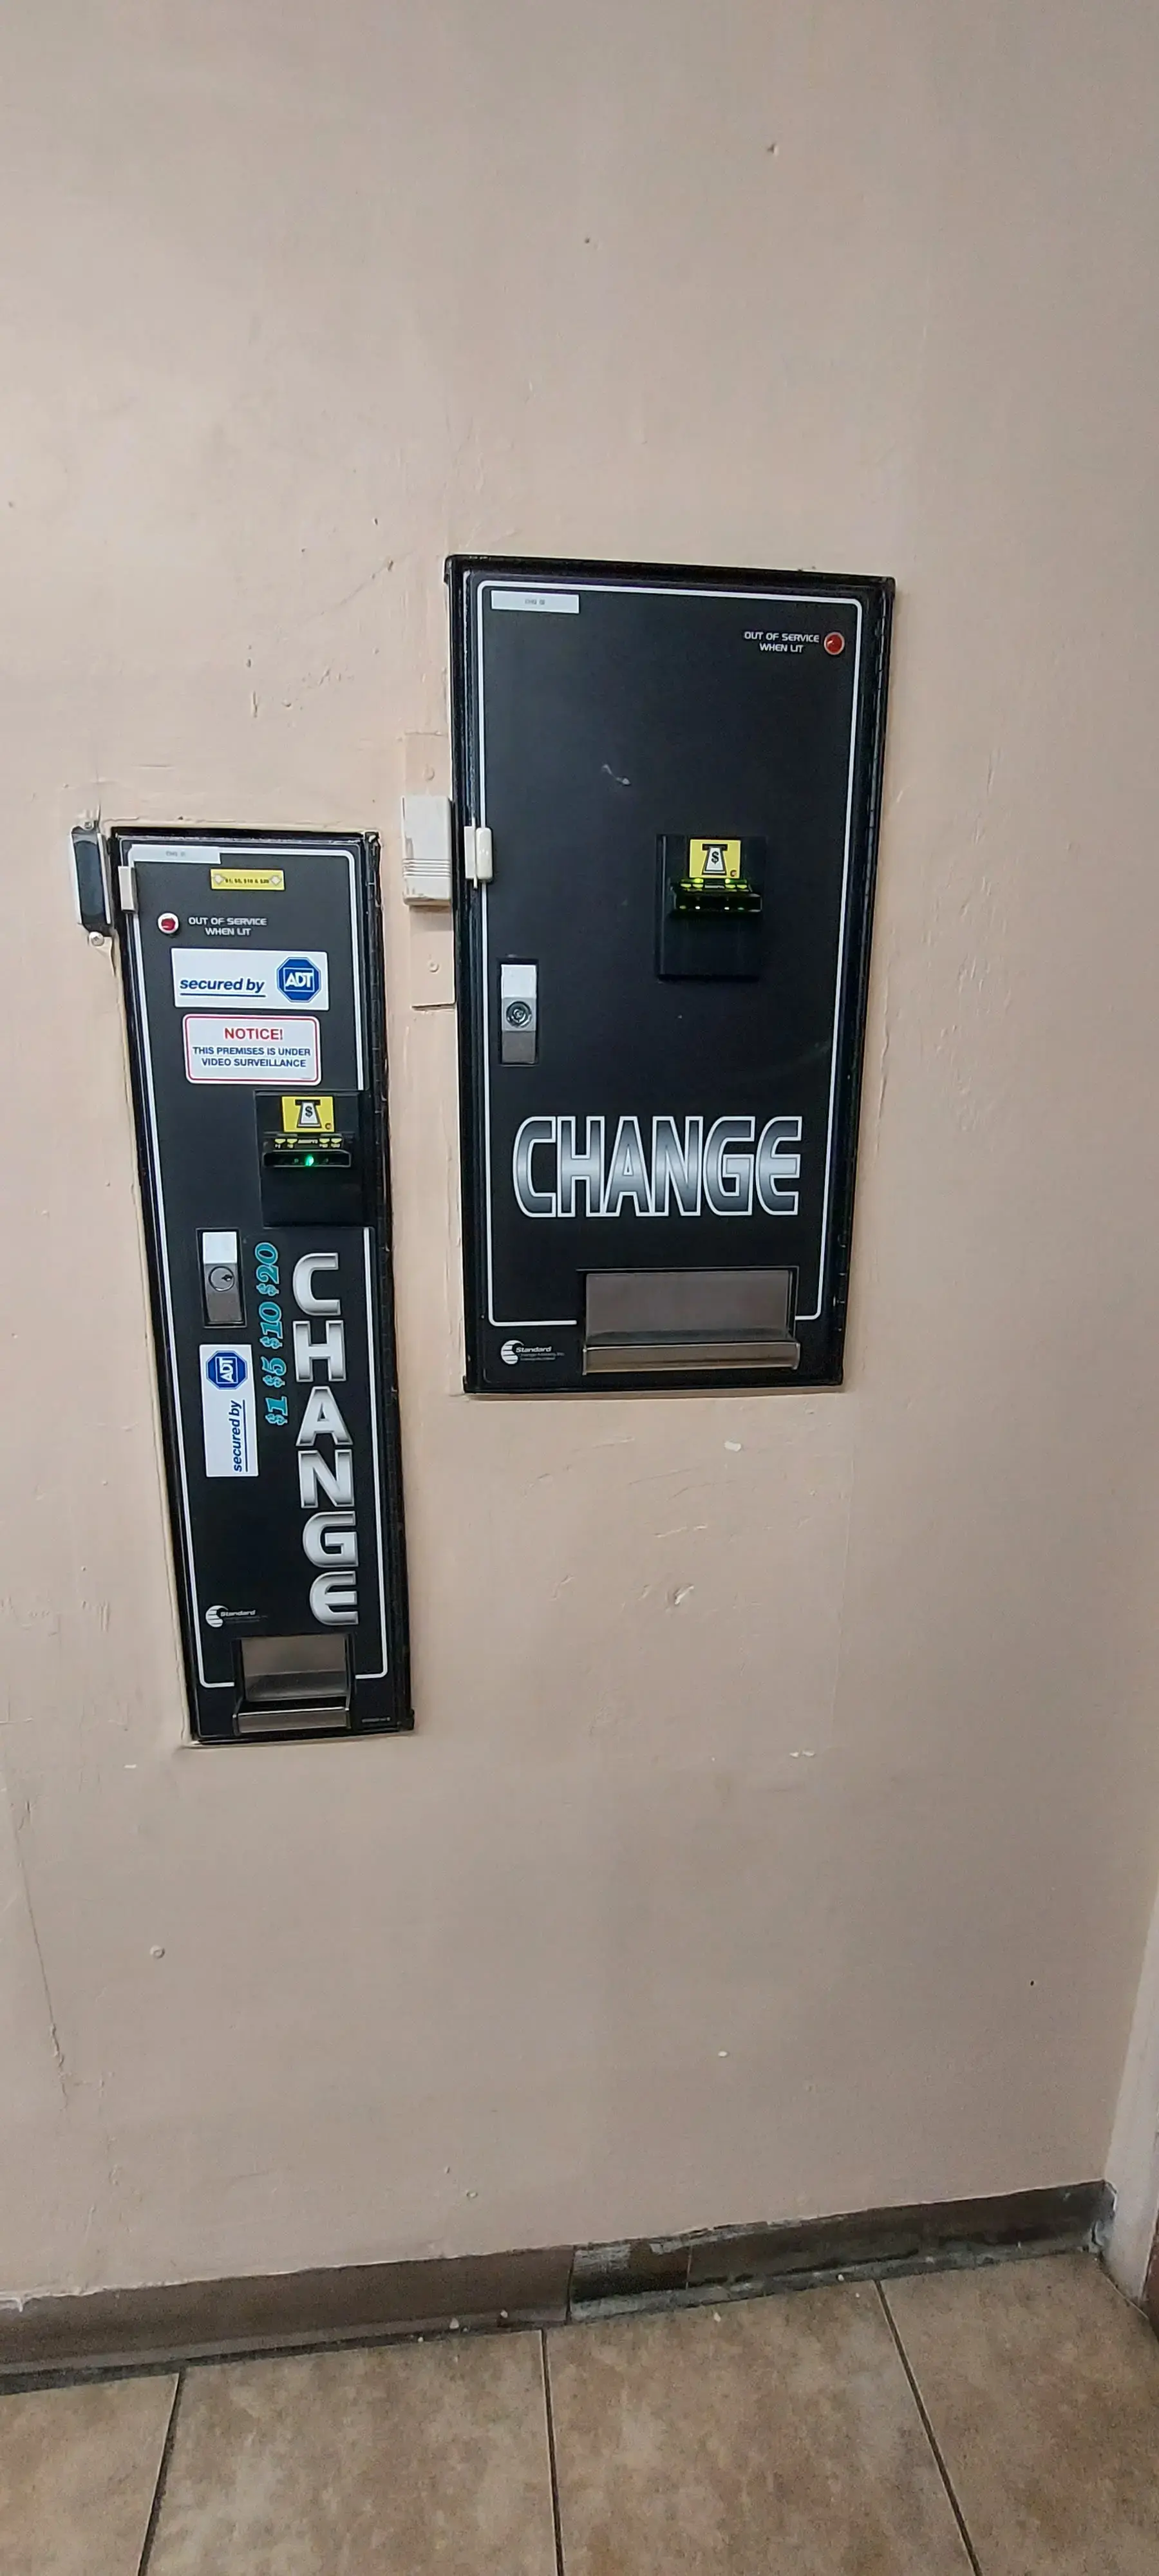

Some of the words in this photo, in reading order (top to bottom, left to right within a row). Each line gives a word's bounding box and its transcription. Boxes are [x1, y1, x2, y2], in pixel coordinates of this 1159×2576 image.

[744, 631, 764, 639] OUT
[782, 634, 820, 642] SERVICE
[759, 643, 787, 652] WHEN
[188, 917, 209, 925] OUT
[211, 917, 225, 925] OF
[226, 918, 268, 926] SERVICE
[205, 927, 235, 936] WHEN
[180, 978, 243, 990] secured
[245, 978, 265, 993] by
[285, 971, 314, 989] ADT
[224, 1028, 283, 1040] NOTICE!
[193, 1046, 214, 1055] THIS
[216, 1047, 265, 1056] PREMISES
[202, 1058, 232, 1066] VIDEO
[234, 1059, 306, 1067] SURVEILLANCE
[513, 1116, 802, 1217] CHANGE
[254, 1242, 279, 1297] $20
[259, 1301, 283, 1350] $10
[218, 1356, 234, 1383] ADT
[261, 1356, 287, 1388] $5
[229, 1399, 242, 1417] by
[265, 1396, 288, 1426] $1
[229, 1418, 243, 1472] secured
[292, 1252, 359, 1626] CHANGE
